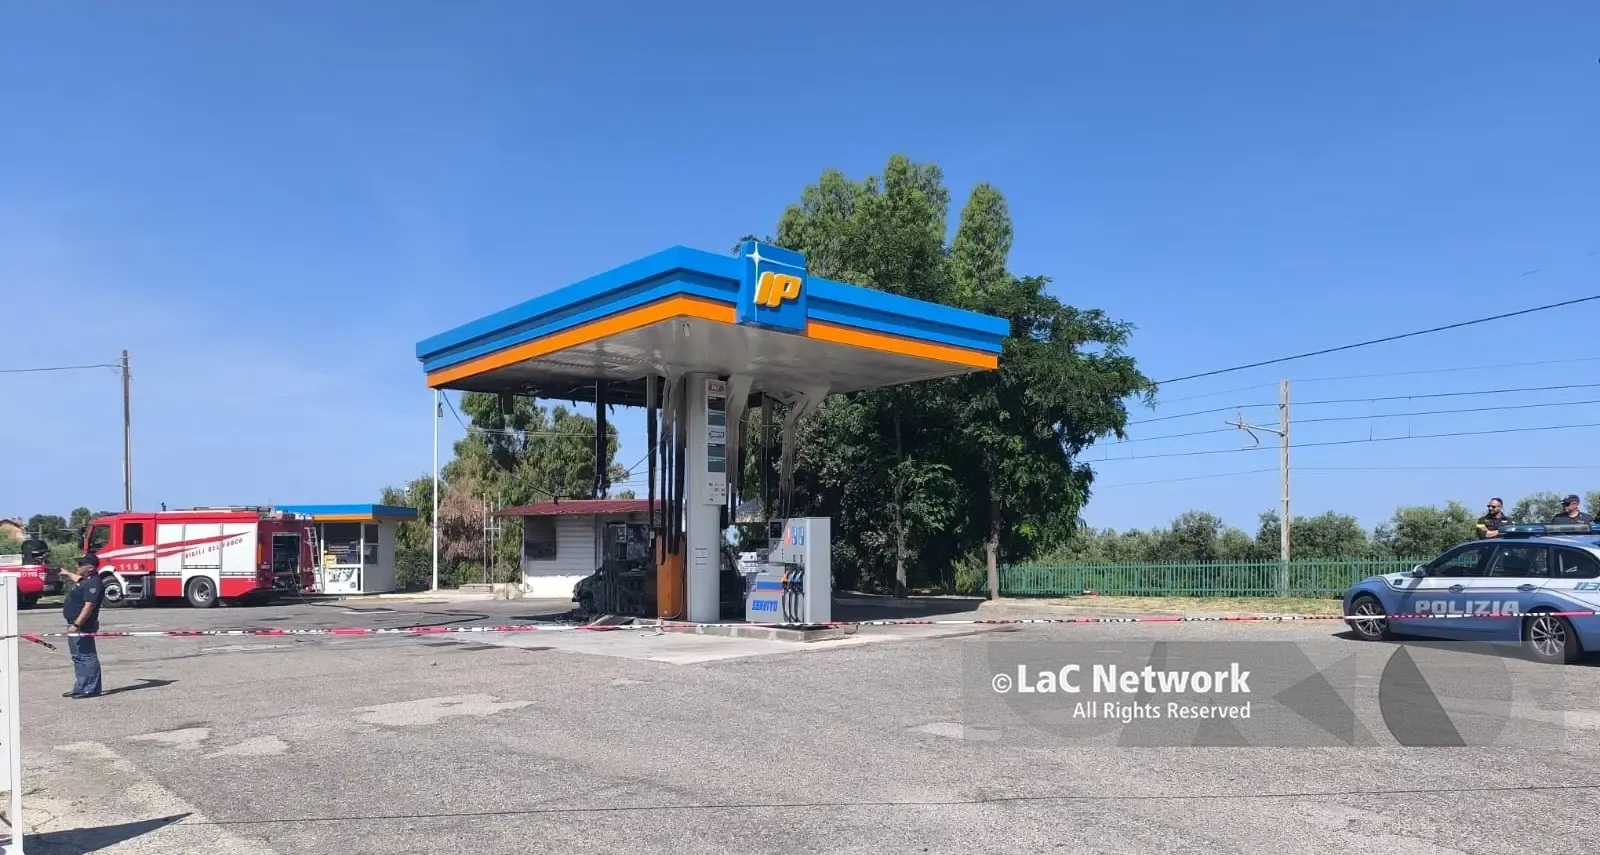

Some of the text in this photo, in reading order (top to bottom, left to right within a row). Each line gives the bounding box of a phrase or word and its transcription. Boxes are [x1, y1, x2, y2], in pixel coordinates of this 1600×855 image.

[754, 272, 802, 308] IP
[751, 600, 778, 611] SERVITO
[1415, 600, 1520, 615] POLIZIA
